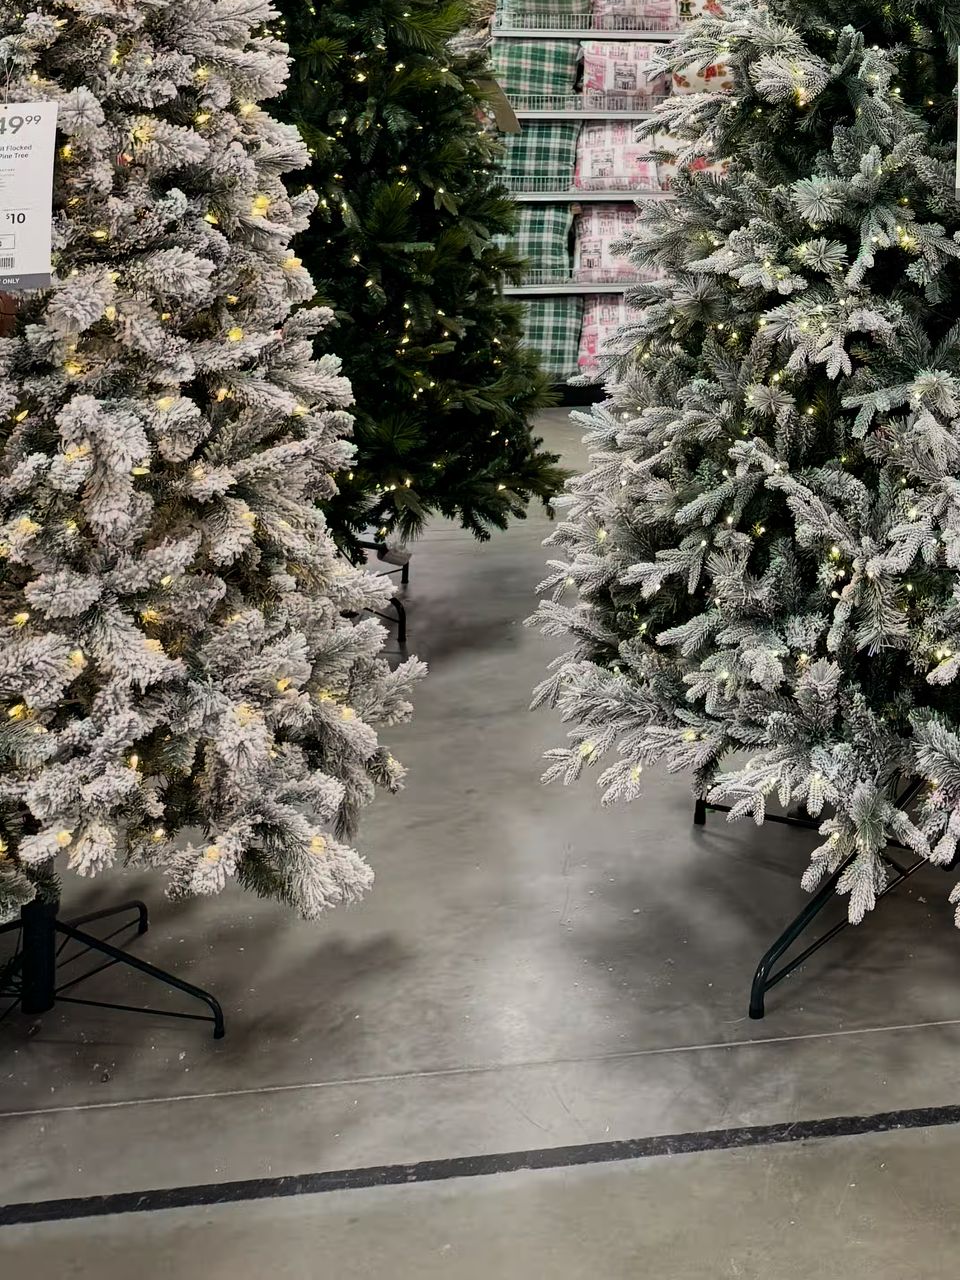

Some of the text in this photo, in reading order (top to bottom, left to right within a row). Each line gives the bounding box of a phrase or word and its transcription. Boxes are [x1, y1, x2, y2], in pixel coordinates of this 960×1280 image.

[6, 144, 33, 152] Flocked
[6, 212, 26, 225] $10
[2, 277, 20, 285] ONLY
